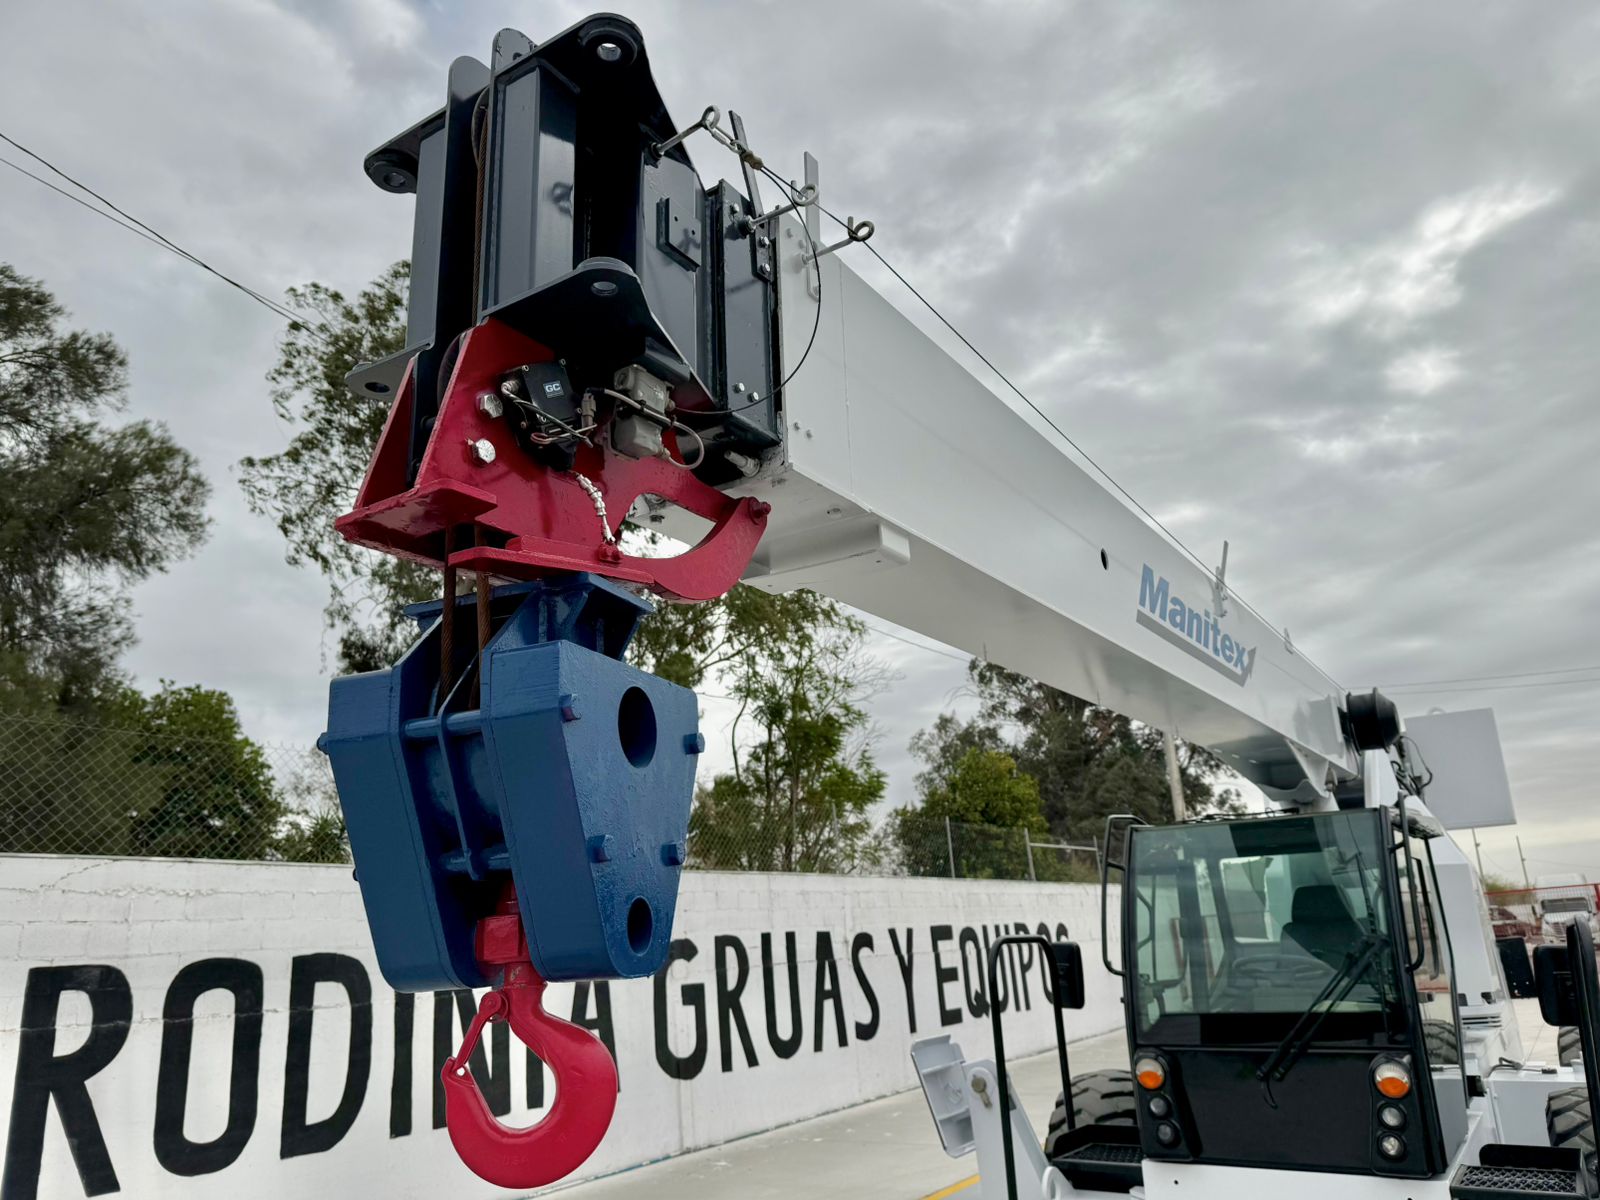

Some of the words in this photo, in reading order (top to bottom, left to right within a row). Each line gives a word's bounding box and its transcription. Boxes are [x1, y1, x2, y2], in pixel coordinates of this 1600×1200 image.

[545, 383, 561, 393] GC
[1139, 563, 1246, 671] Manitex
[653, 930, 880, 1081] GRUAS
[888, 927, 917, 1034] Y
[930, 921, 1069, 1027] EQUIPO
